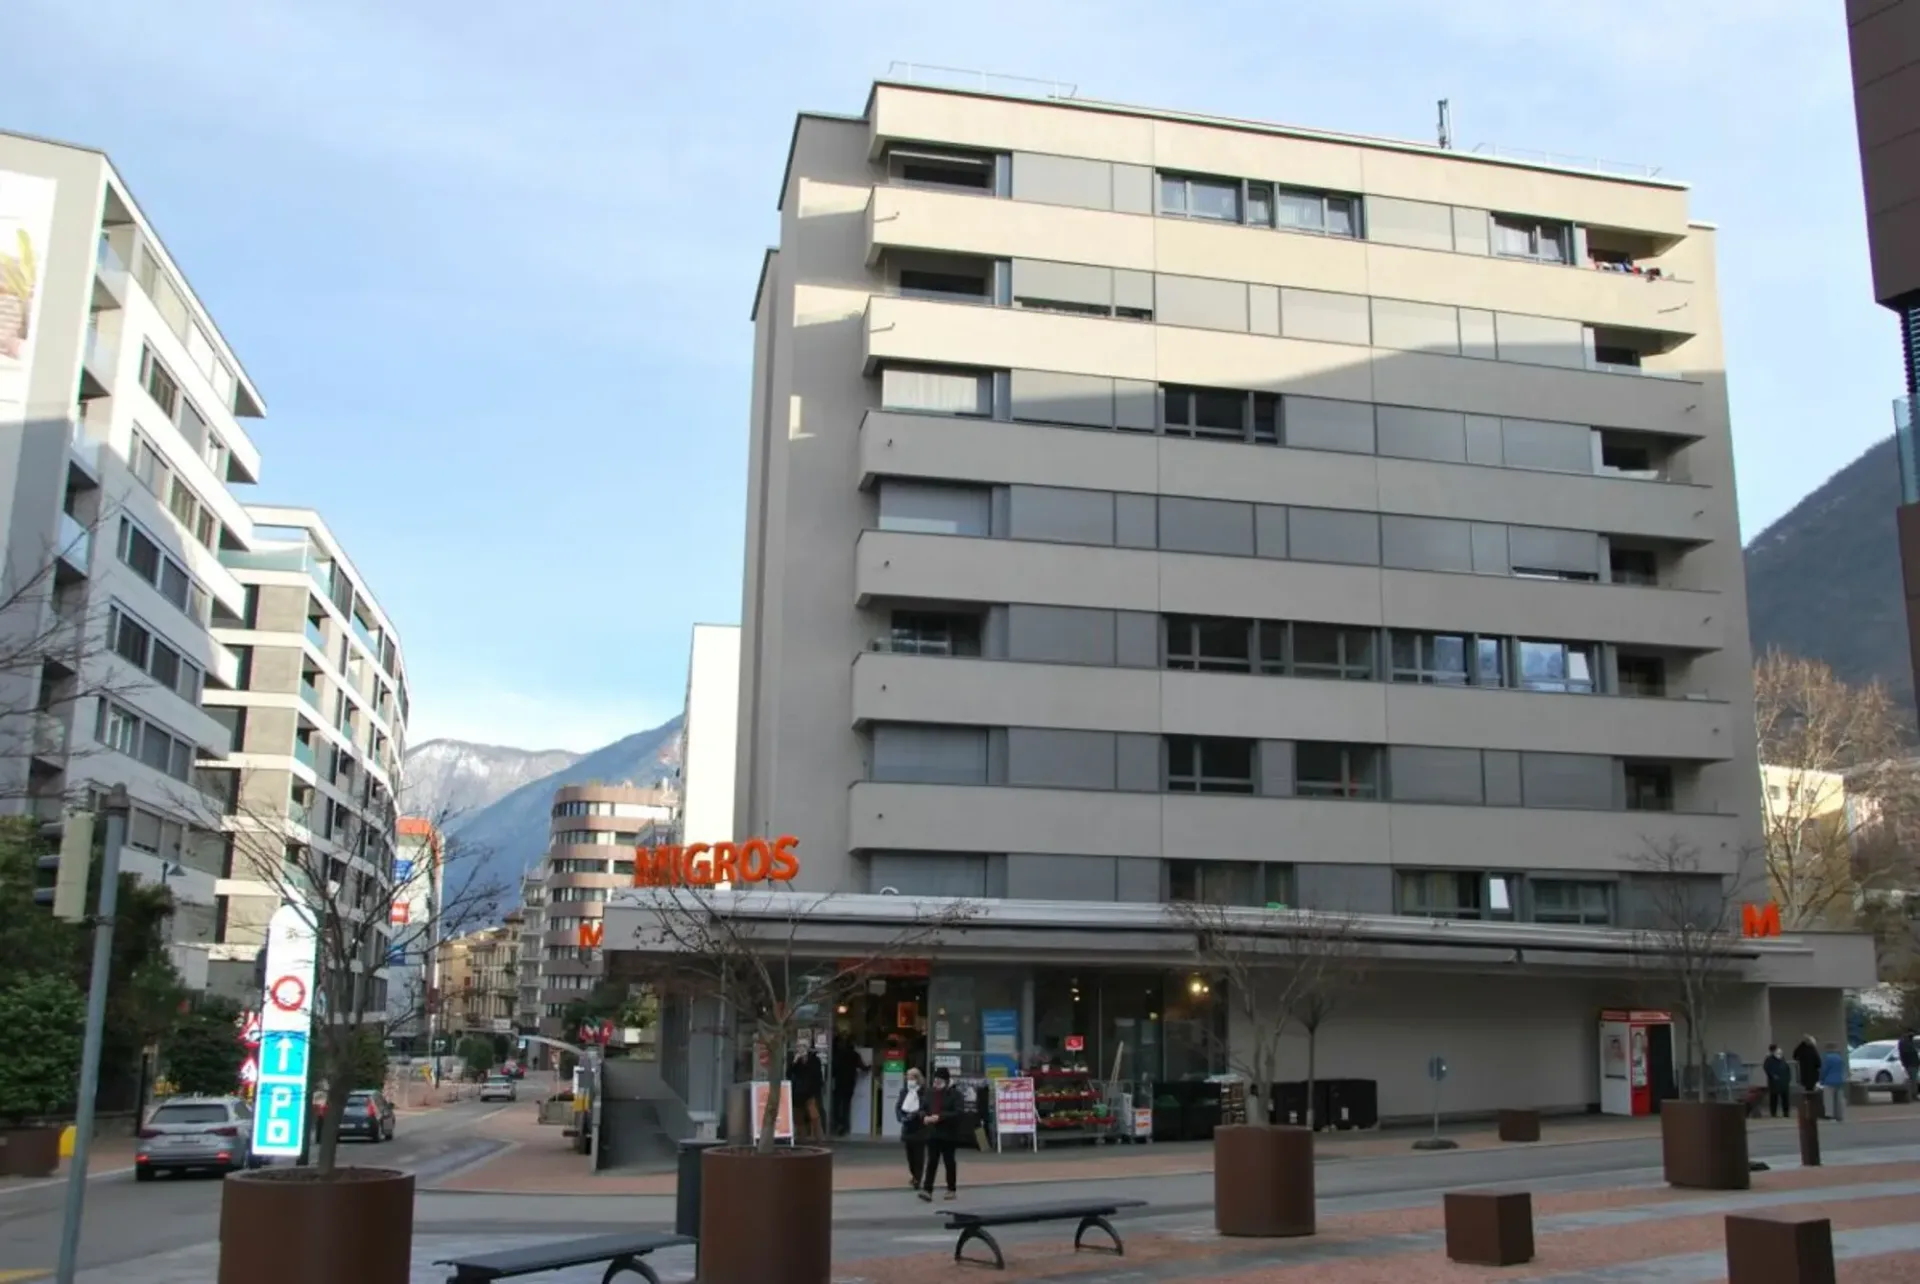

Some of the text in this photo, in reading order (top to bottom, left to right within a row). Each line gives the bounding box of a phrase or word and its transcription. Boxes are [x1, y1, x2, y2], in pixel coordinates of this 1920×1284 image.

[633, 834, 799, 888] MIGROS
[1743, 902, 1780, 938] M
[271, 1086, 291, 1118] P
